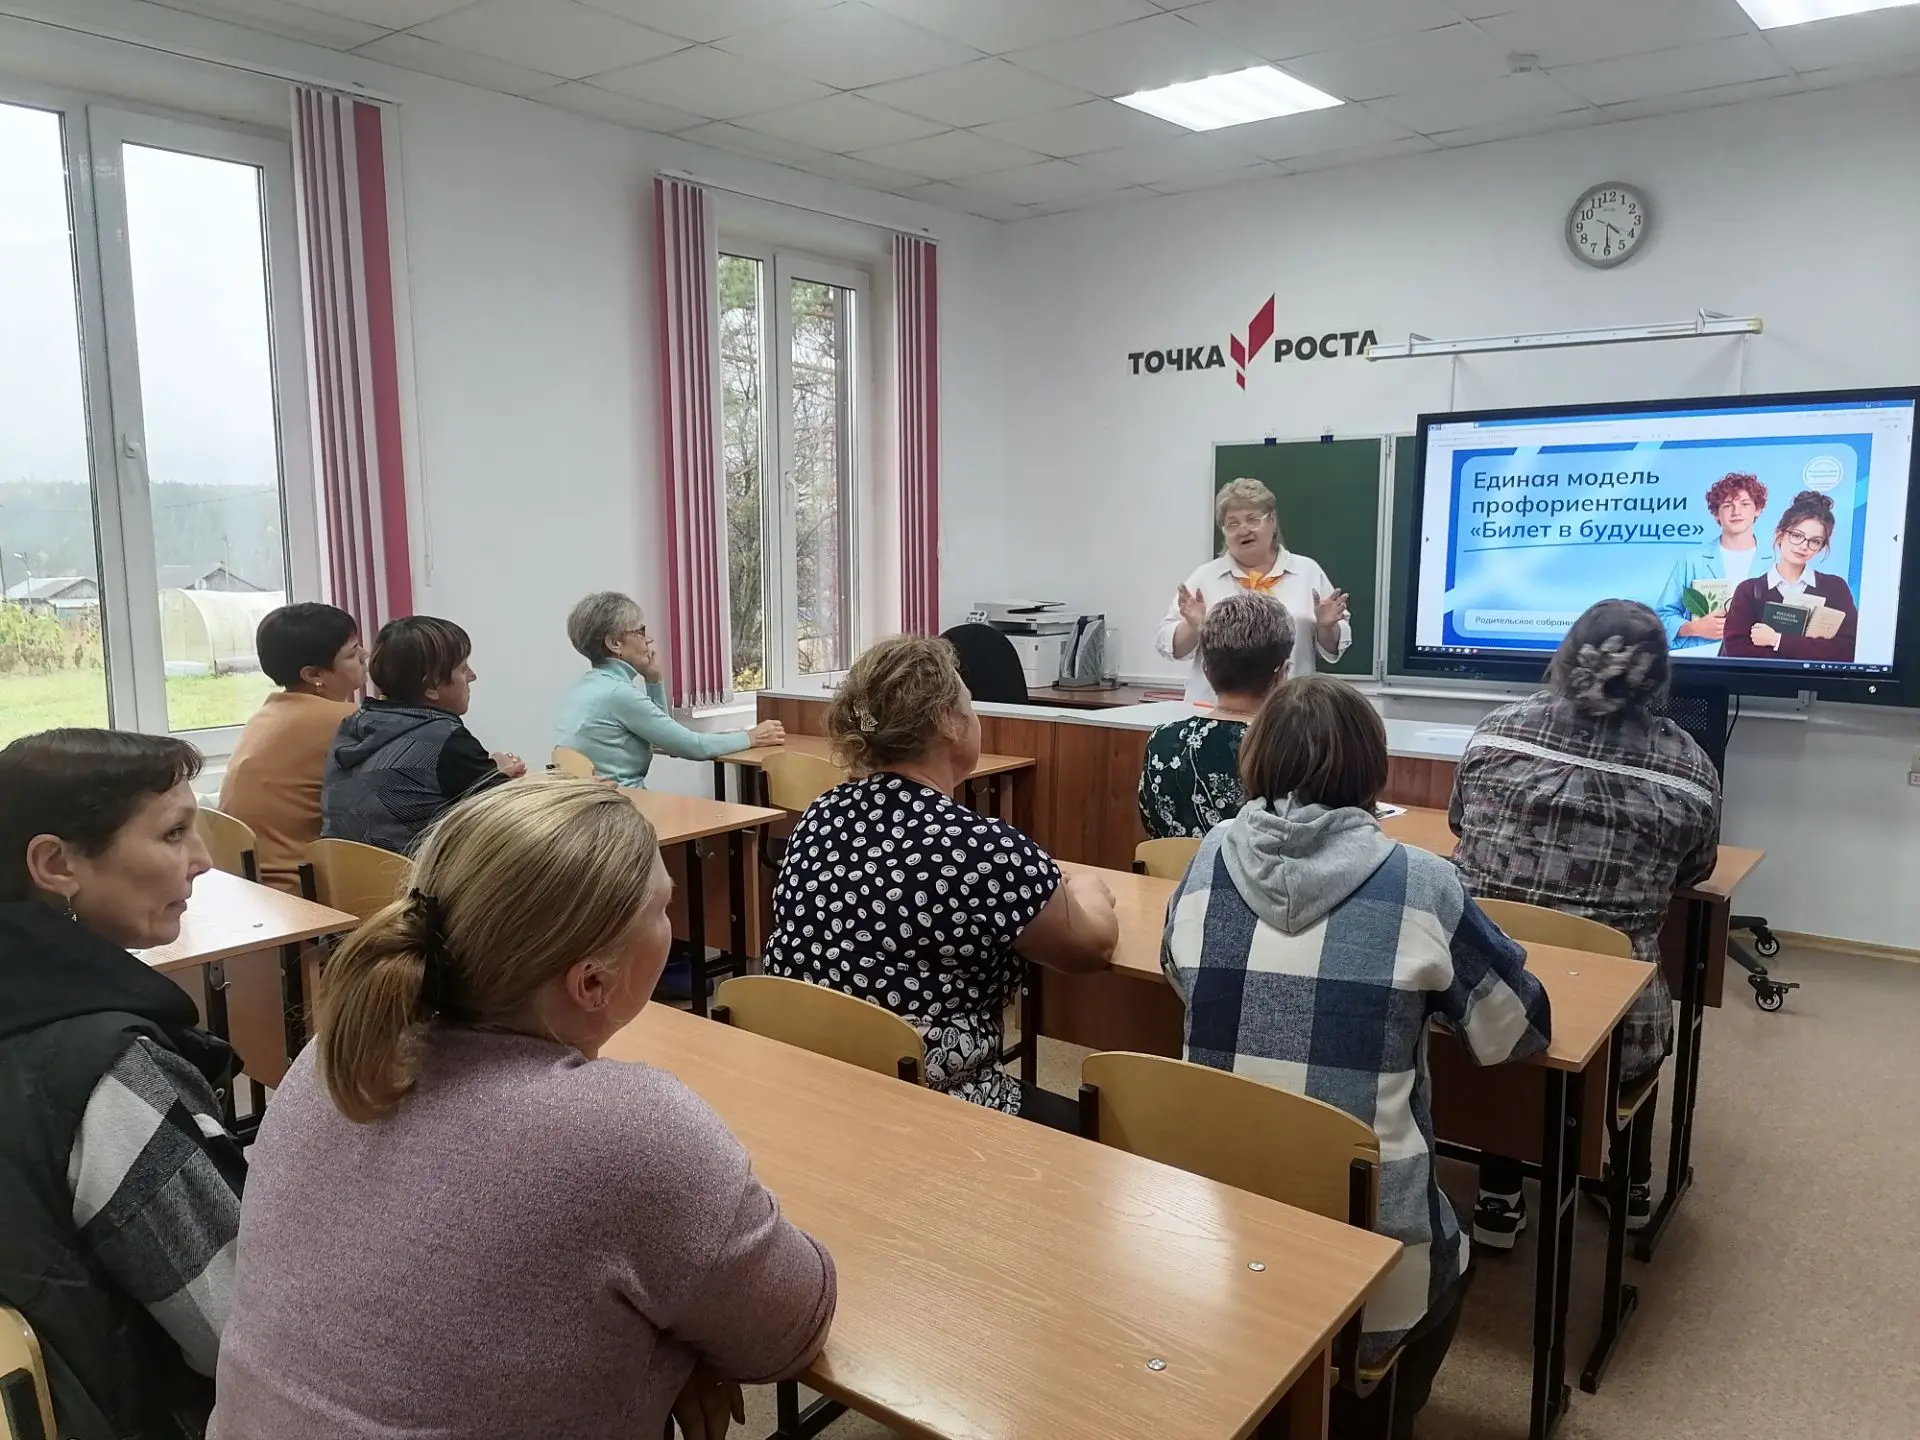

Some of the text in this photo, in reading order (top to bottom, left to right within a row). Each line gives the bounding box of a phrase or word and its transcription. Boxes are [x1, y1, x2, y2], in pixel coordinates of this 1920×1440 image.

[1602, 191, 1617, 203] 12
[1620, 193, 1625, 205] 1
[1591, 197, 1602, 209] 11
[1628, 203, 1635, 214] 2
[1581, 209, 1594, 220] 10
[1633, 215, 1641, 225] 3
[1576, 222, 1583, 233] 9
[1627, 227, 1634, 238] 4
[1580, 233, 1588, 244] 8
[1590, 242, 1597, 253] 7
[1618, 239, 1625, 250] 5
[1603, 245, 1610, 256] 6
[1127, 329, 1379, 375] ТОЧКА РОСТА
[1474, 471, 1660, 491] Единая модель
[1472, 495, 1688, 518] профориентации
[1470, 519, 1705, 543] «Билет в будущее»
[1475, 615, 1534, 626] Родительское
